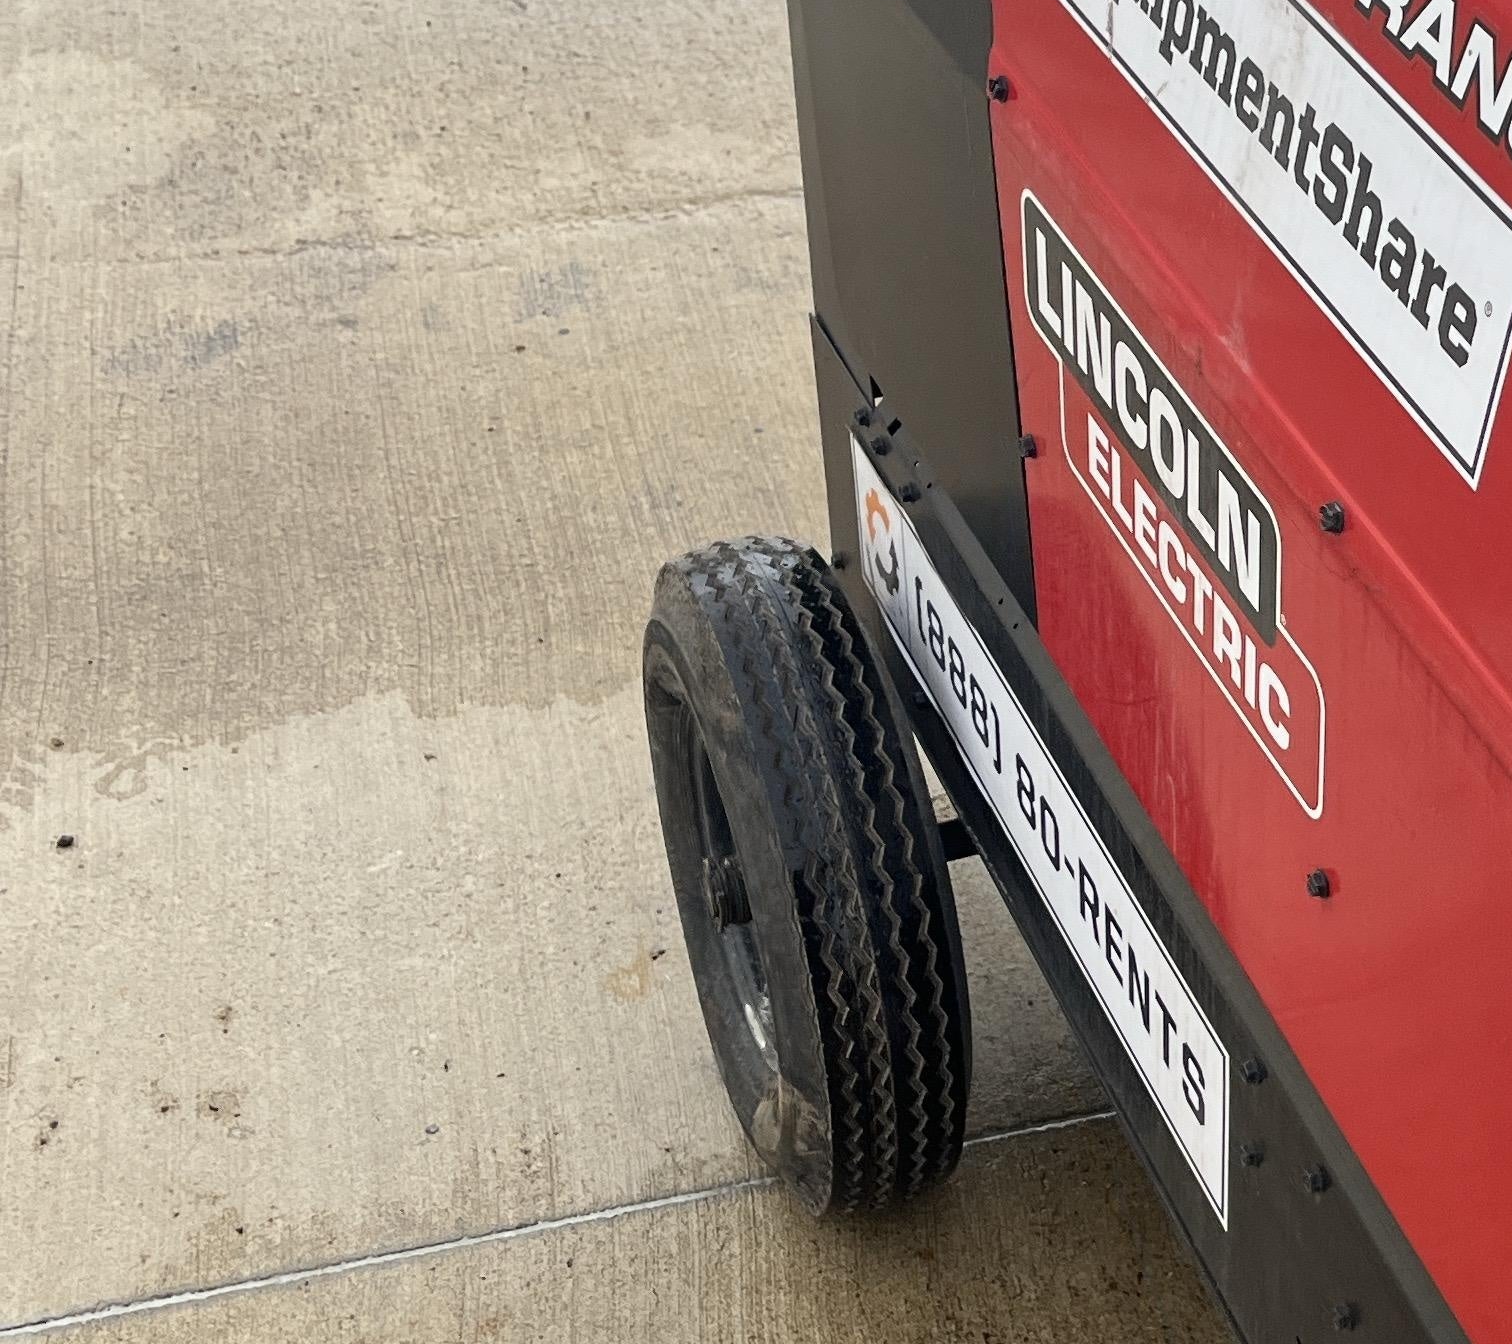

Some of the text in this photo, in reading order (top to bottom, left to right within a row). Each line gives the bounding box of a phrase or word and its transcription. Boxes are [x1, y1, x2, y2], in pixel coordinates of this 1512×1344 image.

[1035, 227, 1262, 612] LINCOLN
[1087, 412, 1292, 750] ELECTRIC
[915, 577, 1206, 1127] (888) 80-RENTS
